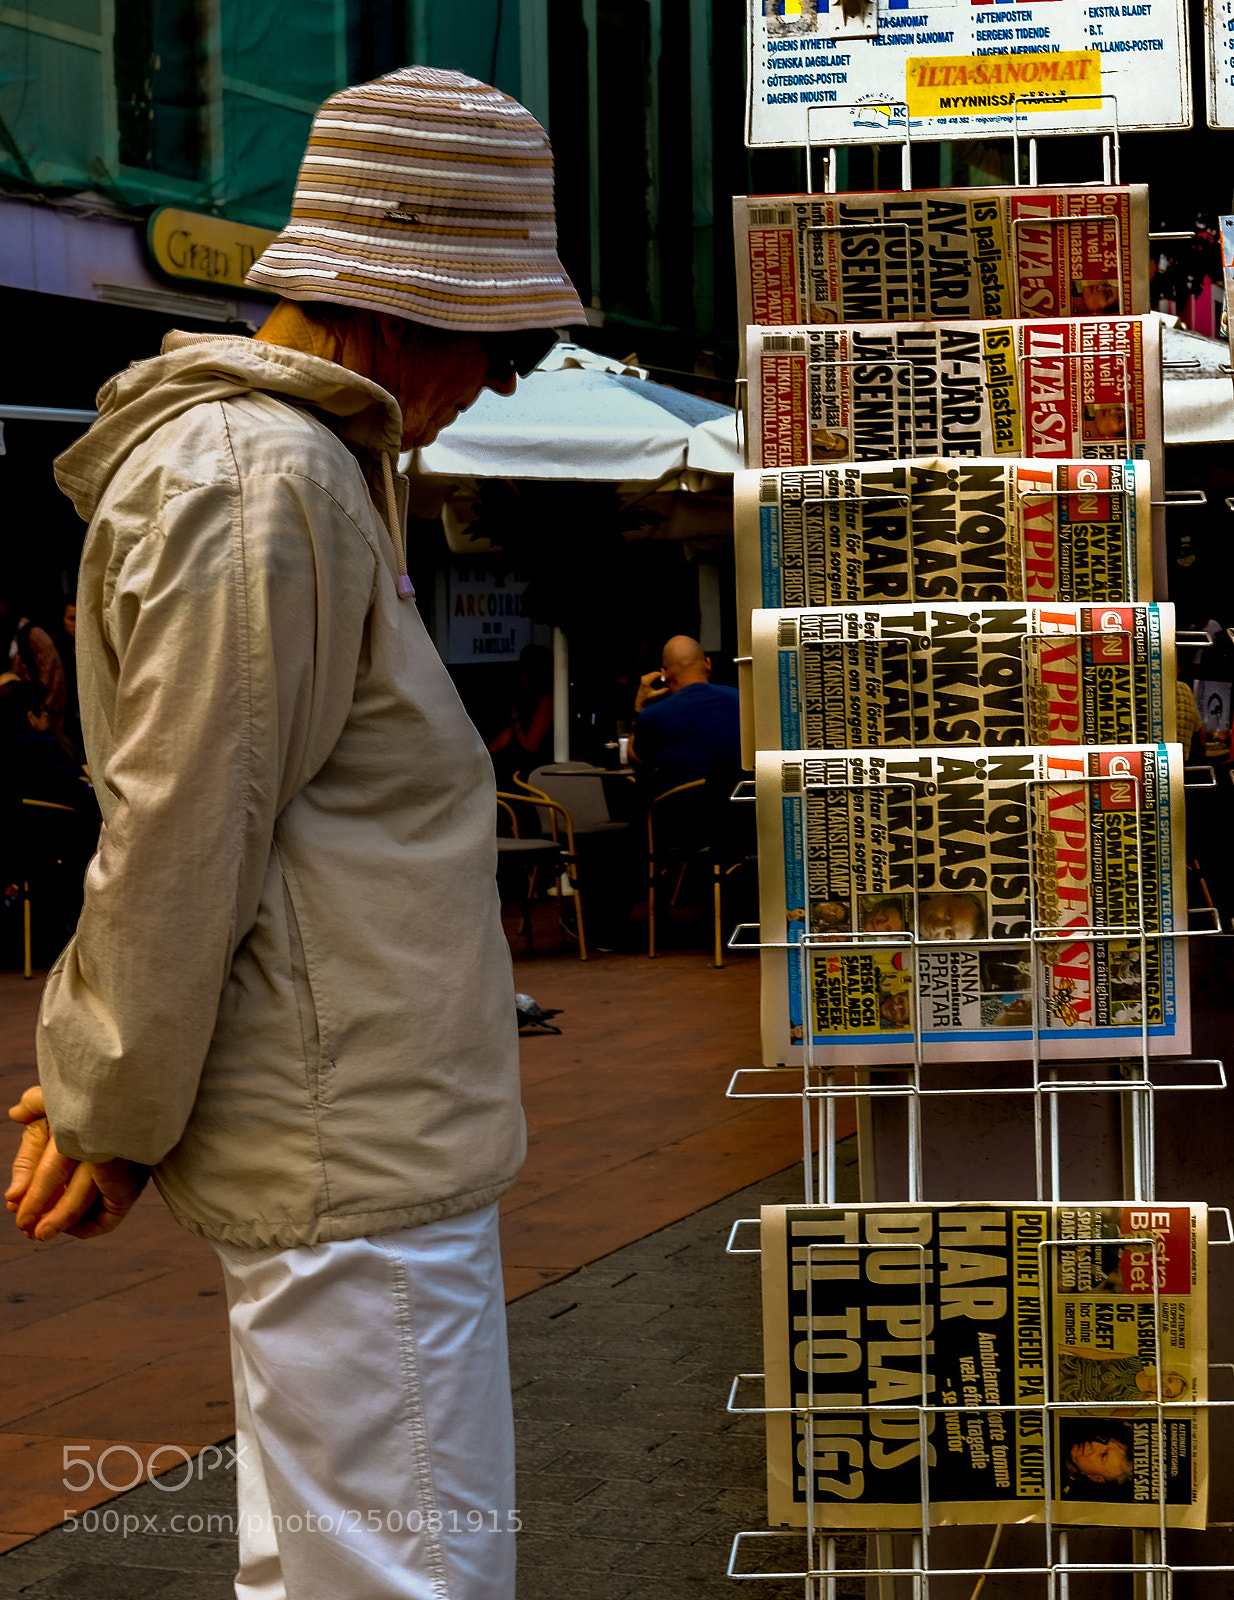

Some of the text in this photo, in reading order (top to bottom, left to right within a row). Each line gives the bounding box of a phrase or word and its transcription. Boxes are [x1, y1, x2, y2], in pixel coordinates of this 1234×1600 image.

[872, 32, 954, 46] HELSINGIN SANOMAT
[976, 10, 1032, 23] AFTENPOSTEN
[977, 27, 1050, 41] BERGENS TIDENDE
[1089, 5, 1152, 18] EKSTRA BLADET
[1090, 25, 1103, 36] B.T.
[767, 38, 836, 52] DAGENS NYHETER
[767, 55, 850, 69] SVENSKA DAGBLADET
[918, 60, 1092, 87] ILTA-SANOMAT
[1092, 40, 1164, 52] JYLLANDS-POSTEN
[767, 72, 848, 87] GÖTEBORGS-POSTEN
[767, 92, 798, 104] DAGENS
[800, 90, 836, 102] INDUSTRI
[940, 92, 1016, 108] MYYNNISSÄ
[793, 202, 808, 214] jo
[973, 201, 998, 221] IS
[168, 229, 228, 278] Gran
[750, 232, 766, 315] MILJOONILLA
[764, 231, 779, 288] TUKIA JA
[779, 231, 794, 295] Laittomasti
[1087, 238, 1102, 262] veli
[1102, 250, 1117, 272] 33,
[810, 269, 831, 302] jyllää
[1100, 362, 1115, 386] veli
[1133, 322, 1141, 369] KADONNEEN
[762, 358, 777, 439] MILJOONILLA
[777, 357, 790, 413] TUKIA JA
[792, 357, 805, 420] Laittomasti
[807, 331, 823, 420] jo koko maassa
[822, 331, 840, 427] Influenssa jyllää
[984, 329, 1016, 447] IS paljastaa:
[1136, 407, 1144, 438] ALKAA:
[1078, 469, 1098, 514] CNN
[782, 473, 804, 607] ÖVER JOHANNES BROST
[911, 466, 961, 598] ÄNKAS
[1060, 524, 1072, 539] Ny
[1074, 525, 1090, 568] SOM
[1091, 525, 1104, 550] AV
[828, 526, 842, 599] om sorgen
[846, 534, 863, 600] för första
[1060, 543, 1072, 591] kampanj
[1102, 611, 1122, 656] CNN
[1134, 608, 1145, 662] #AsEquals
[881, 612, 931, 743] TÅRAR
[932, 611, 980, 742] ÄNKAS
[1099, 667, 1114, 711] SOM
[1115, 667, 1130, 692] AV
[1150, 611, 1162, 722] LEDARE: M SPRIDER
[823, 660, 845, 748] KÄNSLOKAMP
[848, 670, 862, 744] om sorgen
[866, 678, 882, 744] för första
[1084, 667, 1096, 734] Ny kampanj
[1110, 756, 1131, 803] CNN
[1144, 752, 1154, 809] #AsEquals
[806, 794, 828, 900] JOHANNES BROST
[886, 757, 936, 890] TÅRAR
[938, 757, 987, 890] ÄNKAS
[1091, 813, 1104, 828] Ny
[1107, 814, 1122, 859] SOM
[1124, 814, 1136, 840] AV
[828, 807, 850, 896] KÄNSLOKAMP
[851, 816, 866, 892] om sorgen
[871, 824, 887, 892] för första
[1092, 832, 1104, 882] kampanj
[1095, 886, 1104, 904] om
[1158, 756, 1174, 1016] LEDARE: M SPRIDER MYTER DIESELBILAR
[1140, 814, 1160, 1020] MAMMORNA TVINGAS
[814, 957, 829, 1032] LIVSMEDEL
[828, 957, 842, 1030] 14 SUPER-
[845, 956, 861, 1027] SMAL MED
[860, 955, 876, 1027] FRISK OCH
[931, 953, 950, 1027] PRATAR
[950, 952, 962, 1026] Holmlund
[961, 952, 979, 1005] ANNA
[1094, 961, 1108, 1024] rättigheter
[938, 1212, 1008, 1321] HAR
[1061, 1250, 1076, 1286] FIASKO
[1078, 1256, 1092, 1291] SUCCES
[1151, 1212, 1170, 1289] Ekstra
[791, 1212, 862, 1373] TIL TO
[1117, 1304, 1135, 1322] OG
[865, 1213, 936, 1470] DU PLADS
[1065, 1303, 1076, 1345] nærmeste
[1080, 1303, 1093, 1342] hos mine
[1095, 1304, 1113, 1350] KRÆFT
[1138, 1304, 1156, 1367] MISBRUG
[1017, 1214, 1045, 1493] POLITIET RINGEDE PÅ KURT:
[941, 1391, 963, 1453] se hvorfor
[959, 1357, 986, 1469] væk tragedie
[978, 1332, 1010, 1488] Ambulancer kørte tomme
[1134, 1423, 1149, 1500] SKATTELY-SAG
